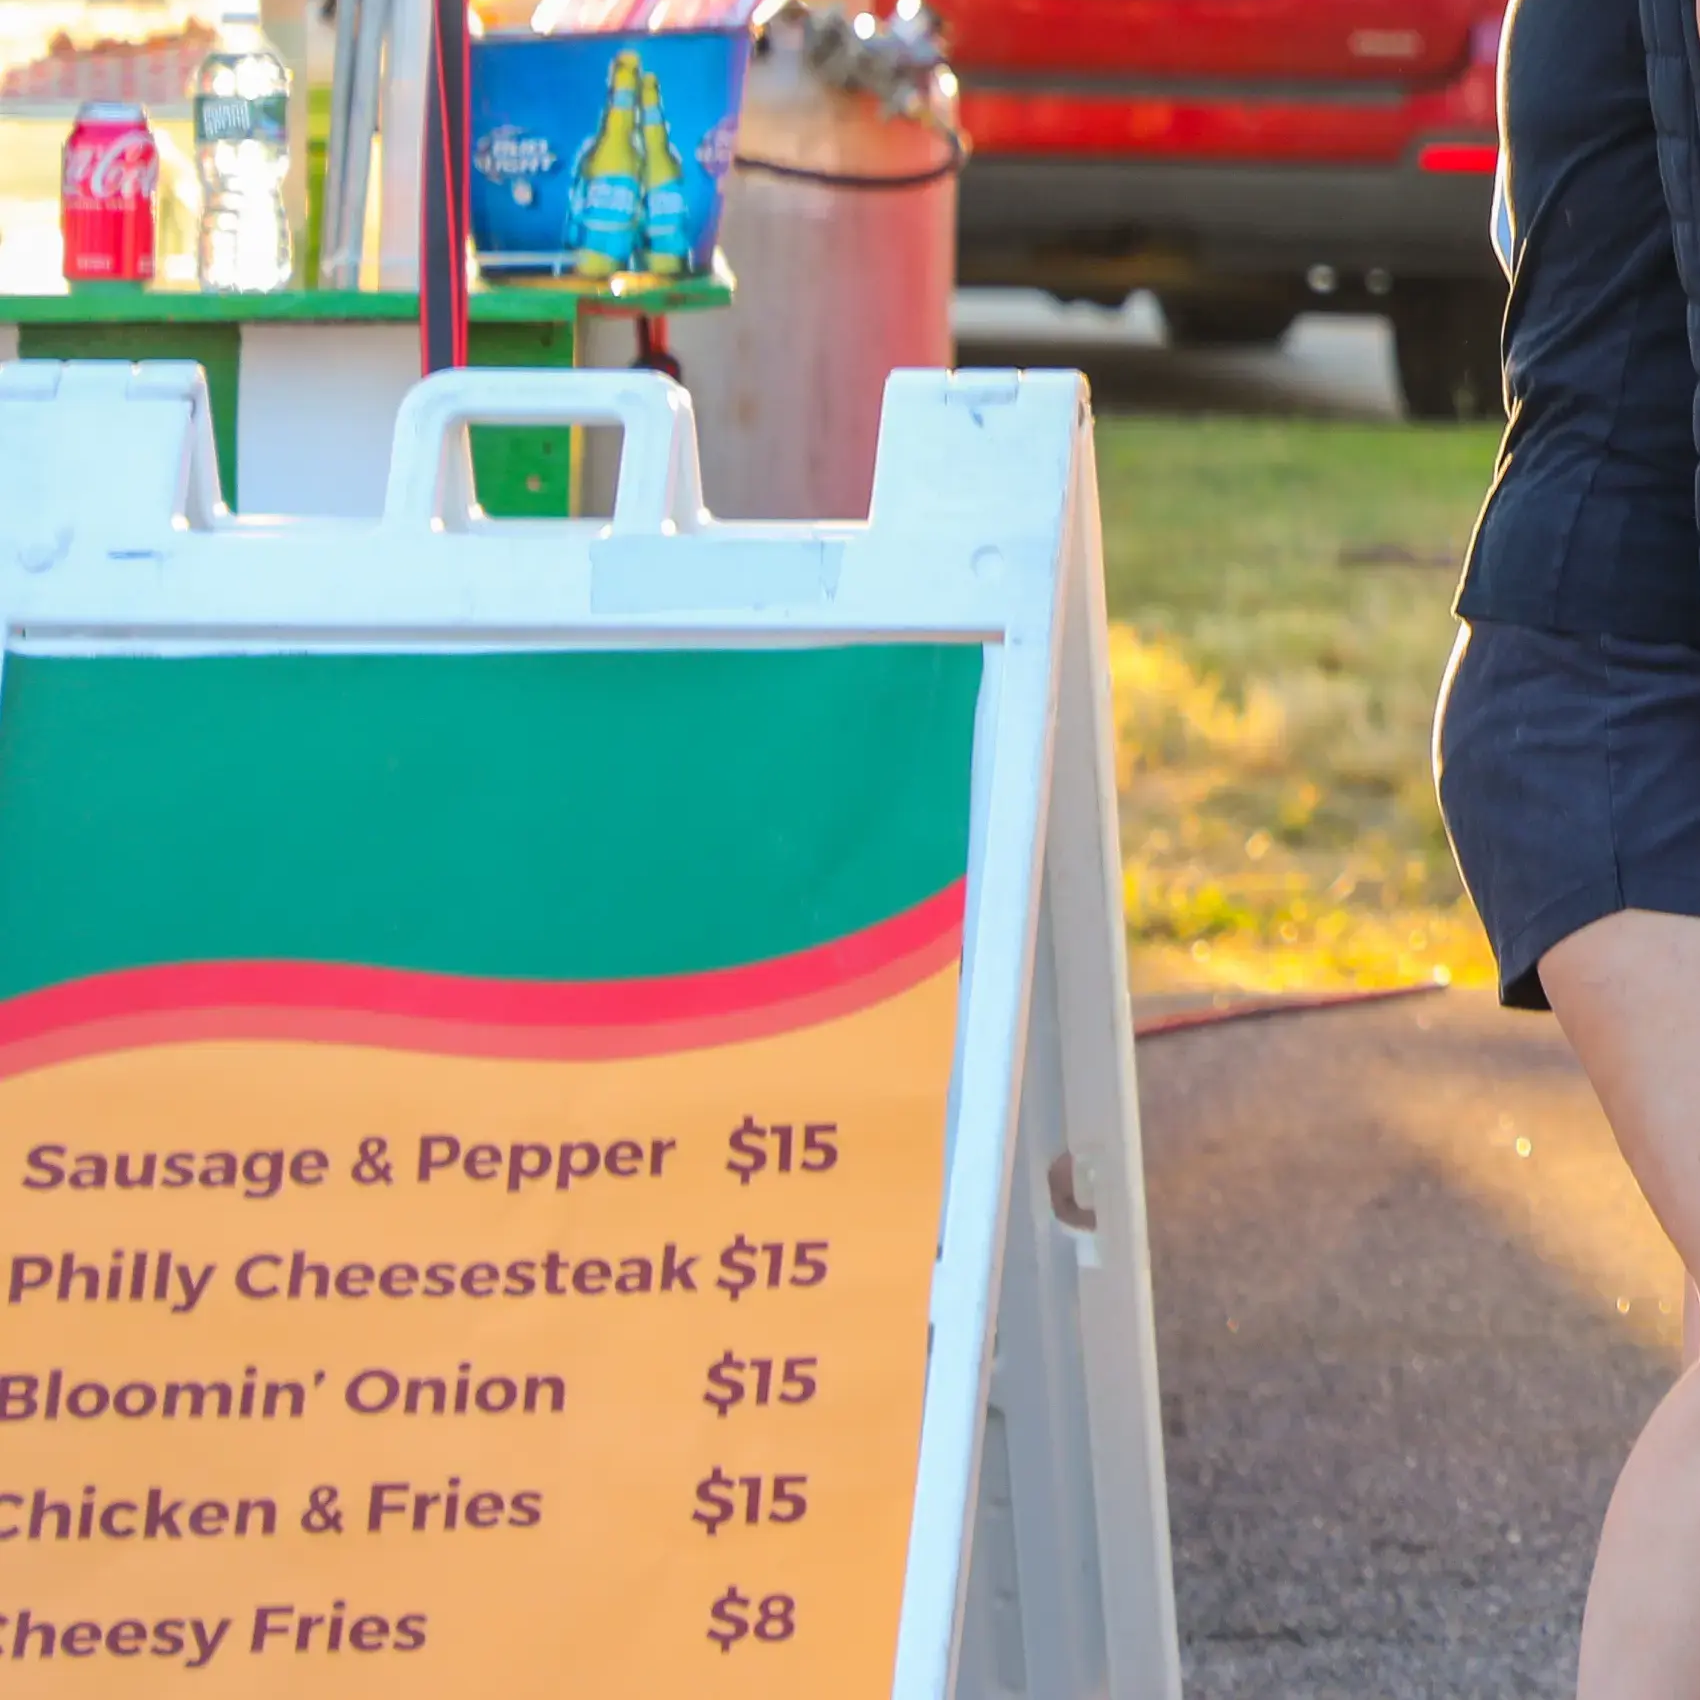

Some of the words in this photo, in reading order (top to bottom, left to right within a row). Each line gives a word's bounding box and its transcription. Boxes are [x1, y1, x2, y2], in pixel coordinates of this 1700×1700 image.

[22, 1143, 330, 1200] Sausage
[350, 1136, 394, 1186] &
[416, 1134, 677, 1193] Pepper
[725, 1114, 840, 1186] $15
[8, 1248, 217, 1314] Philly
[234, 1243, 698, 1300] Cheesesteak
[715, 1233, 830, 1302] $15
[343, 1361, 566, 1415] Onion
[702, 1349, 818, 1418] $15
[299, 1484, 345, 1535] &
[366, 1476, 543, 1533] Fries
[690, 1465, 808, 1537] $15
[0, 1609, 232, 1669] heesy
[249, 1598, 429, 1655] Fries
[705, 1584, 797, 1654] $8
